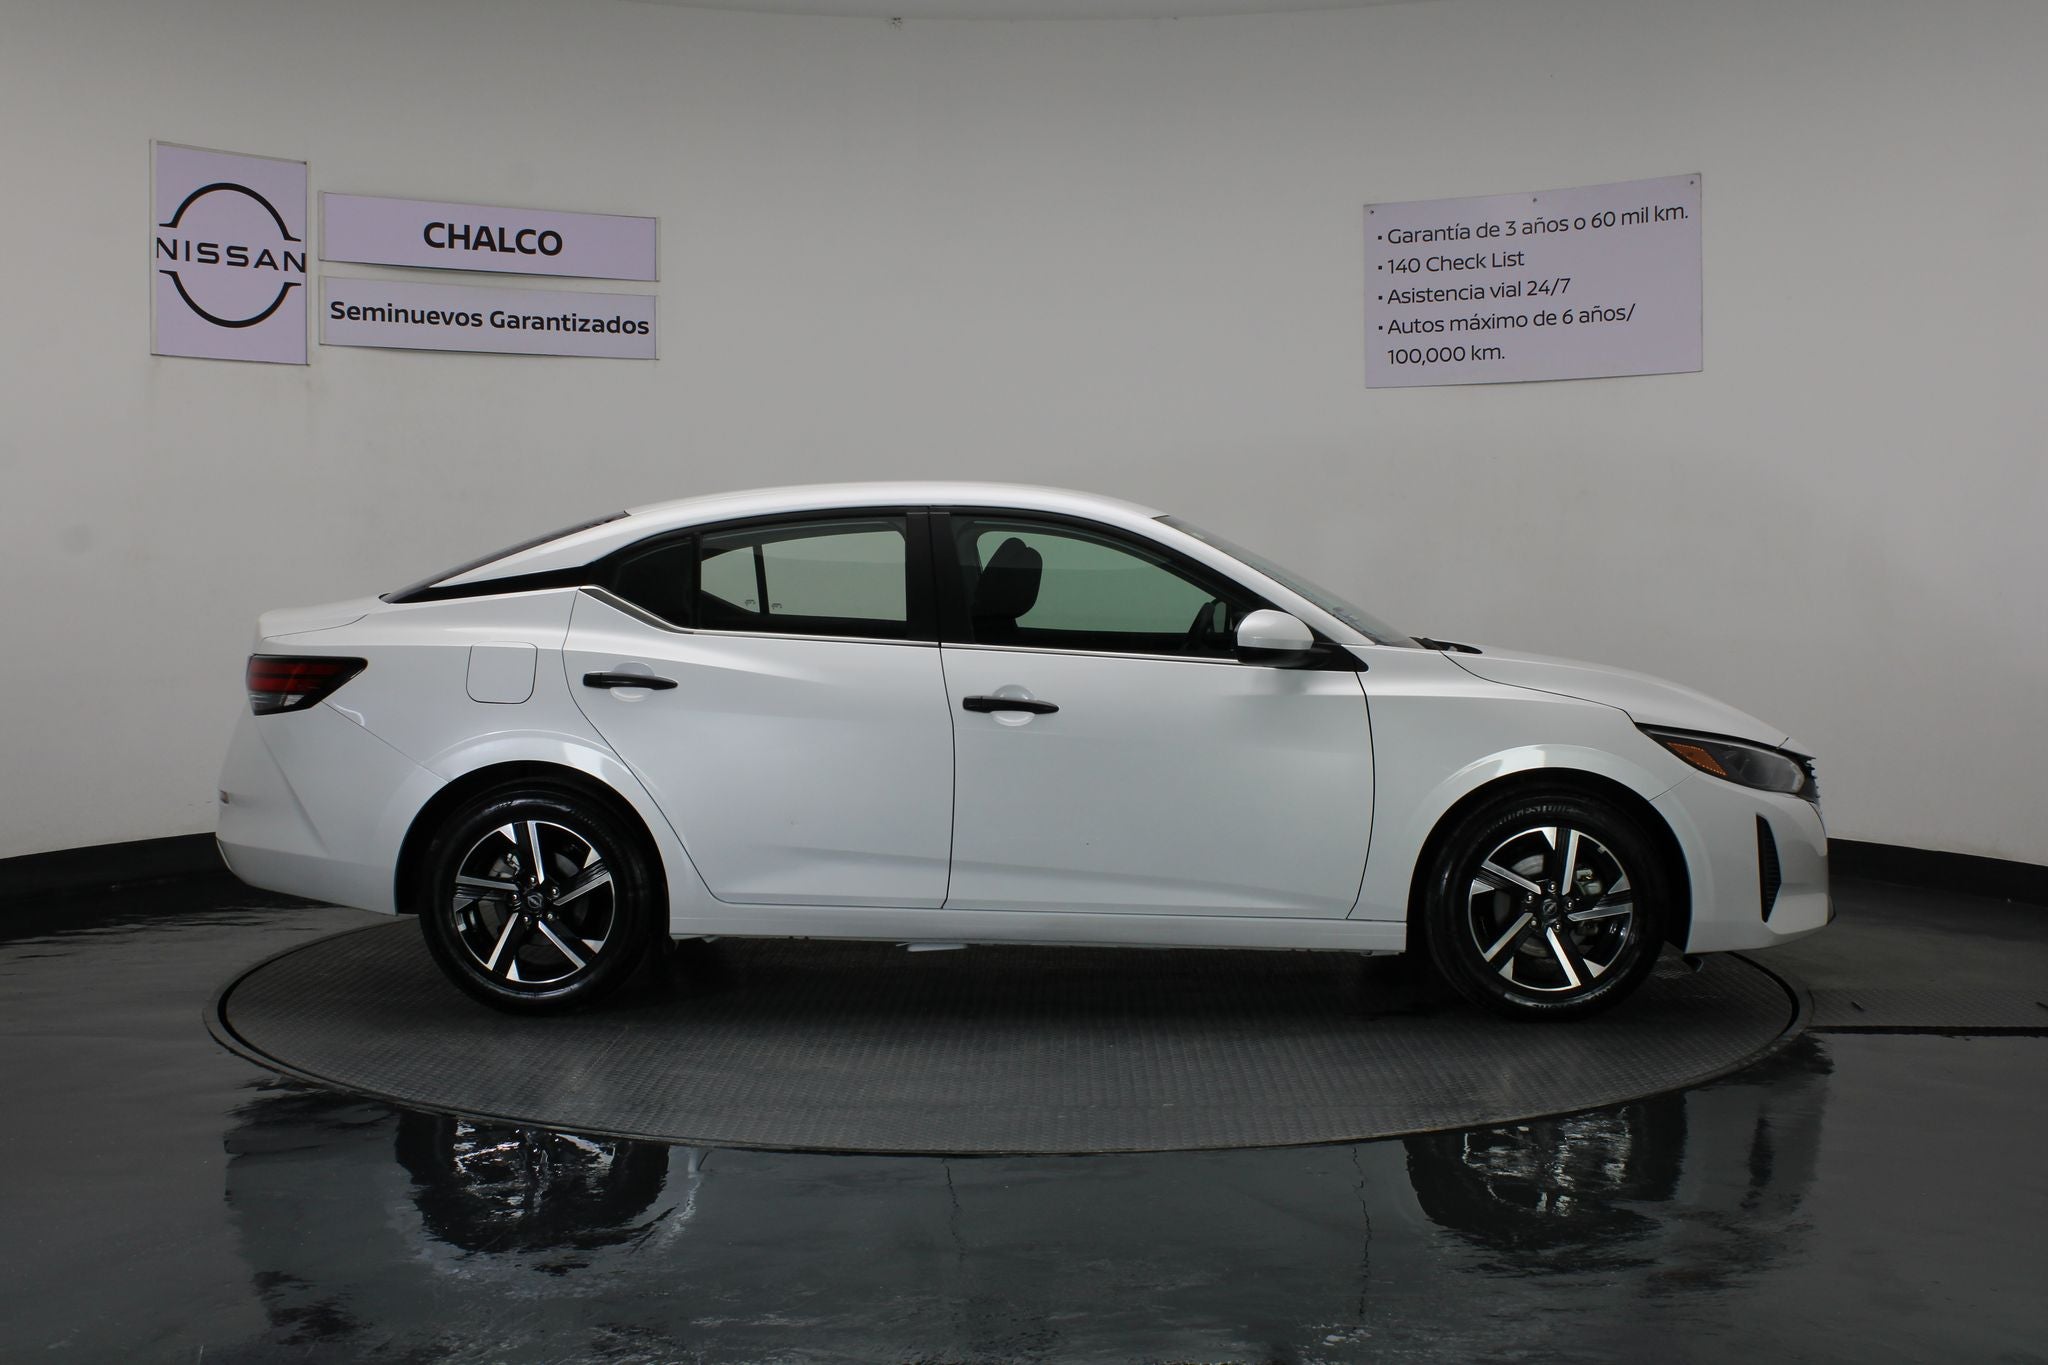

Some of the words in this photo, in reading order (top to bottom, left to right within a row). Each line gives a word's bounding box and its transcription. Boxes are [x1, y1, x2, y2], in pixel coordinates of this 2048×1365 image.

[423, 221, 563, 257] CHALCO
[1387, 222, 1471, 245] Garantía
[1475, 221, 1501, 239] de
[1505, 220, 1517, 237] 3
[1521, 216, 1570, 236] años
[1573, 216, 1587, 231] o
[1590, 210, 1616, 229] 60
[1621, 206, 1649, 226] mil
[1654, 204, 1689, 223] km.
[156, 236, 307, 273] NISSAN
[1387, 257, 1421, 275] 140
[1425, 252, 1487, 273] Check
[1491, 250, 1525, 269] List
[1387, 286, 1485, 305] Asistencia
[1489, 280, 1522, 299] vial
[1526, 277, 1571, 297] 24/7
[330, 301, 484, 328] Seminuevos
[489, 310, 650, 336] Garantizados
[1387, 318, 1445, 335] Autos
[1449, 312, 1529, 332] máximo
[1532, 309, 1558, 327] de
[1561, 308, 1574, 325] 6
[1578, 302, 1636, 325] años/
[1387, 346, 1466, 368] 100,000
[1471, 344, 1506, 361] km.
